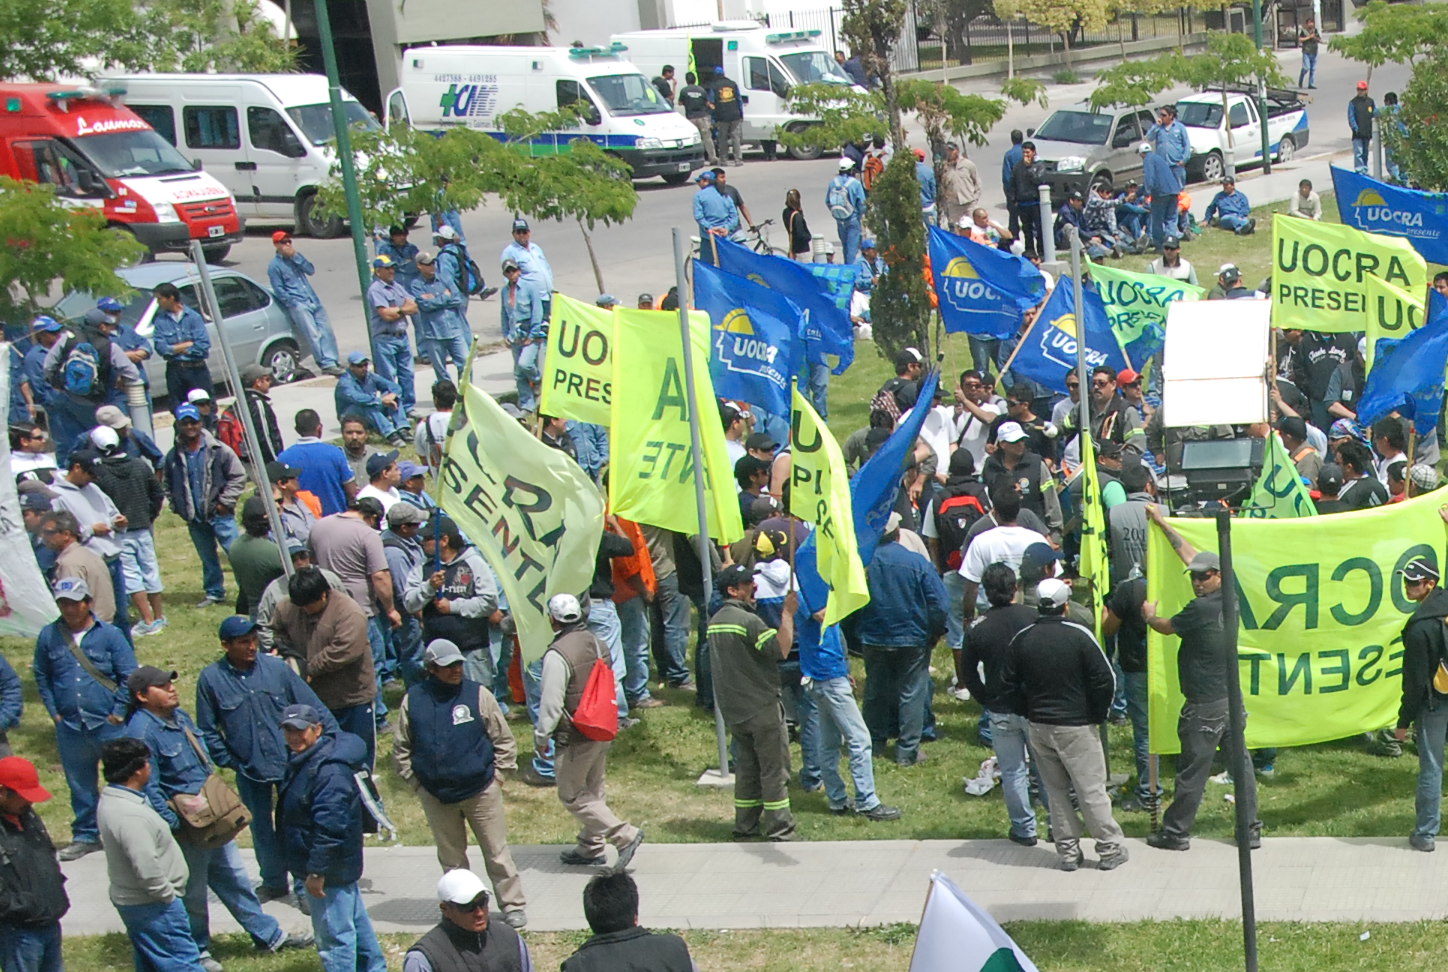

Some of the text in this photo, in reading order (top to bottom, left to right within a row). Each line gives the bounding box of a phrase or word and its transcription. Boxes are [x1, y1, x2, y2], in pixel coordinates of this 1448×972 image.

[1367, 208, 1423, 227] UOCRA
[1406, 227, 1441, 238] presente
[1278, 238, 1412, 287] UOCRA
[558, 319, 613, 366] UO
